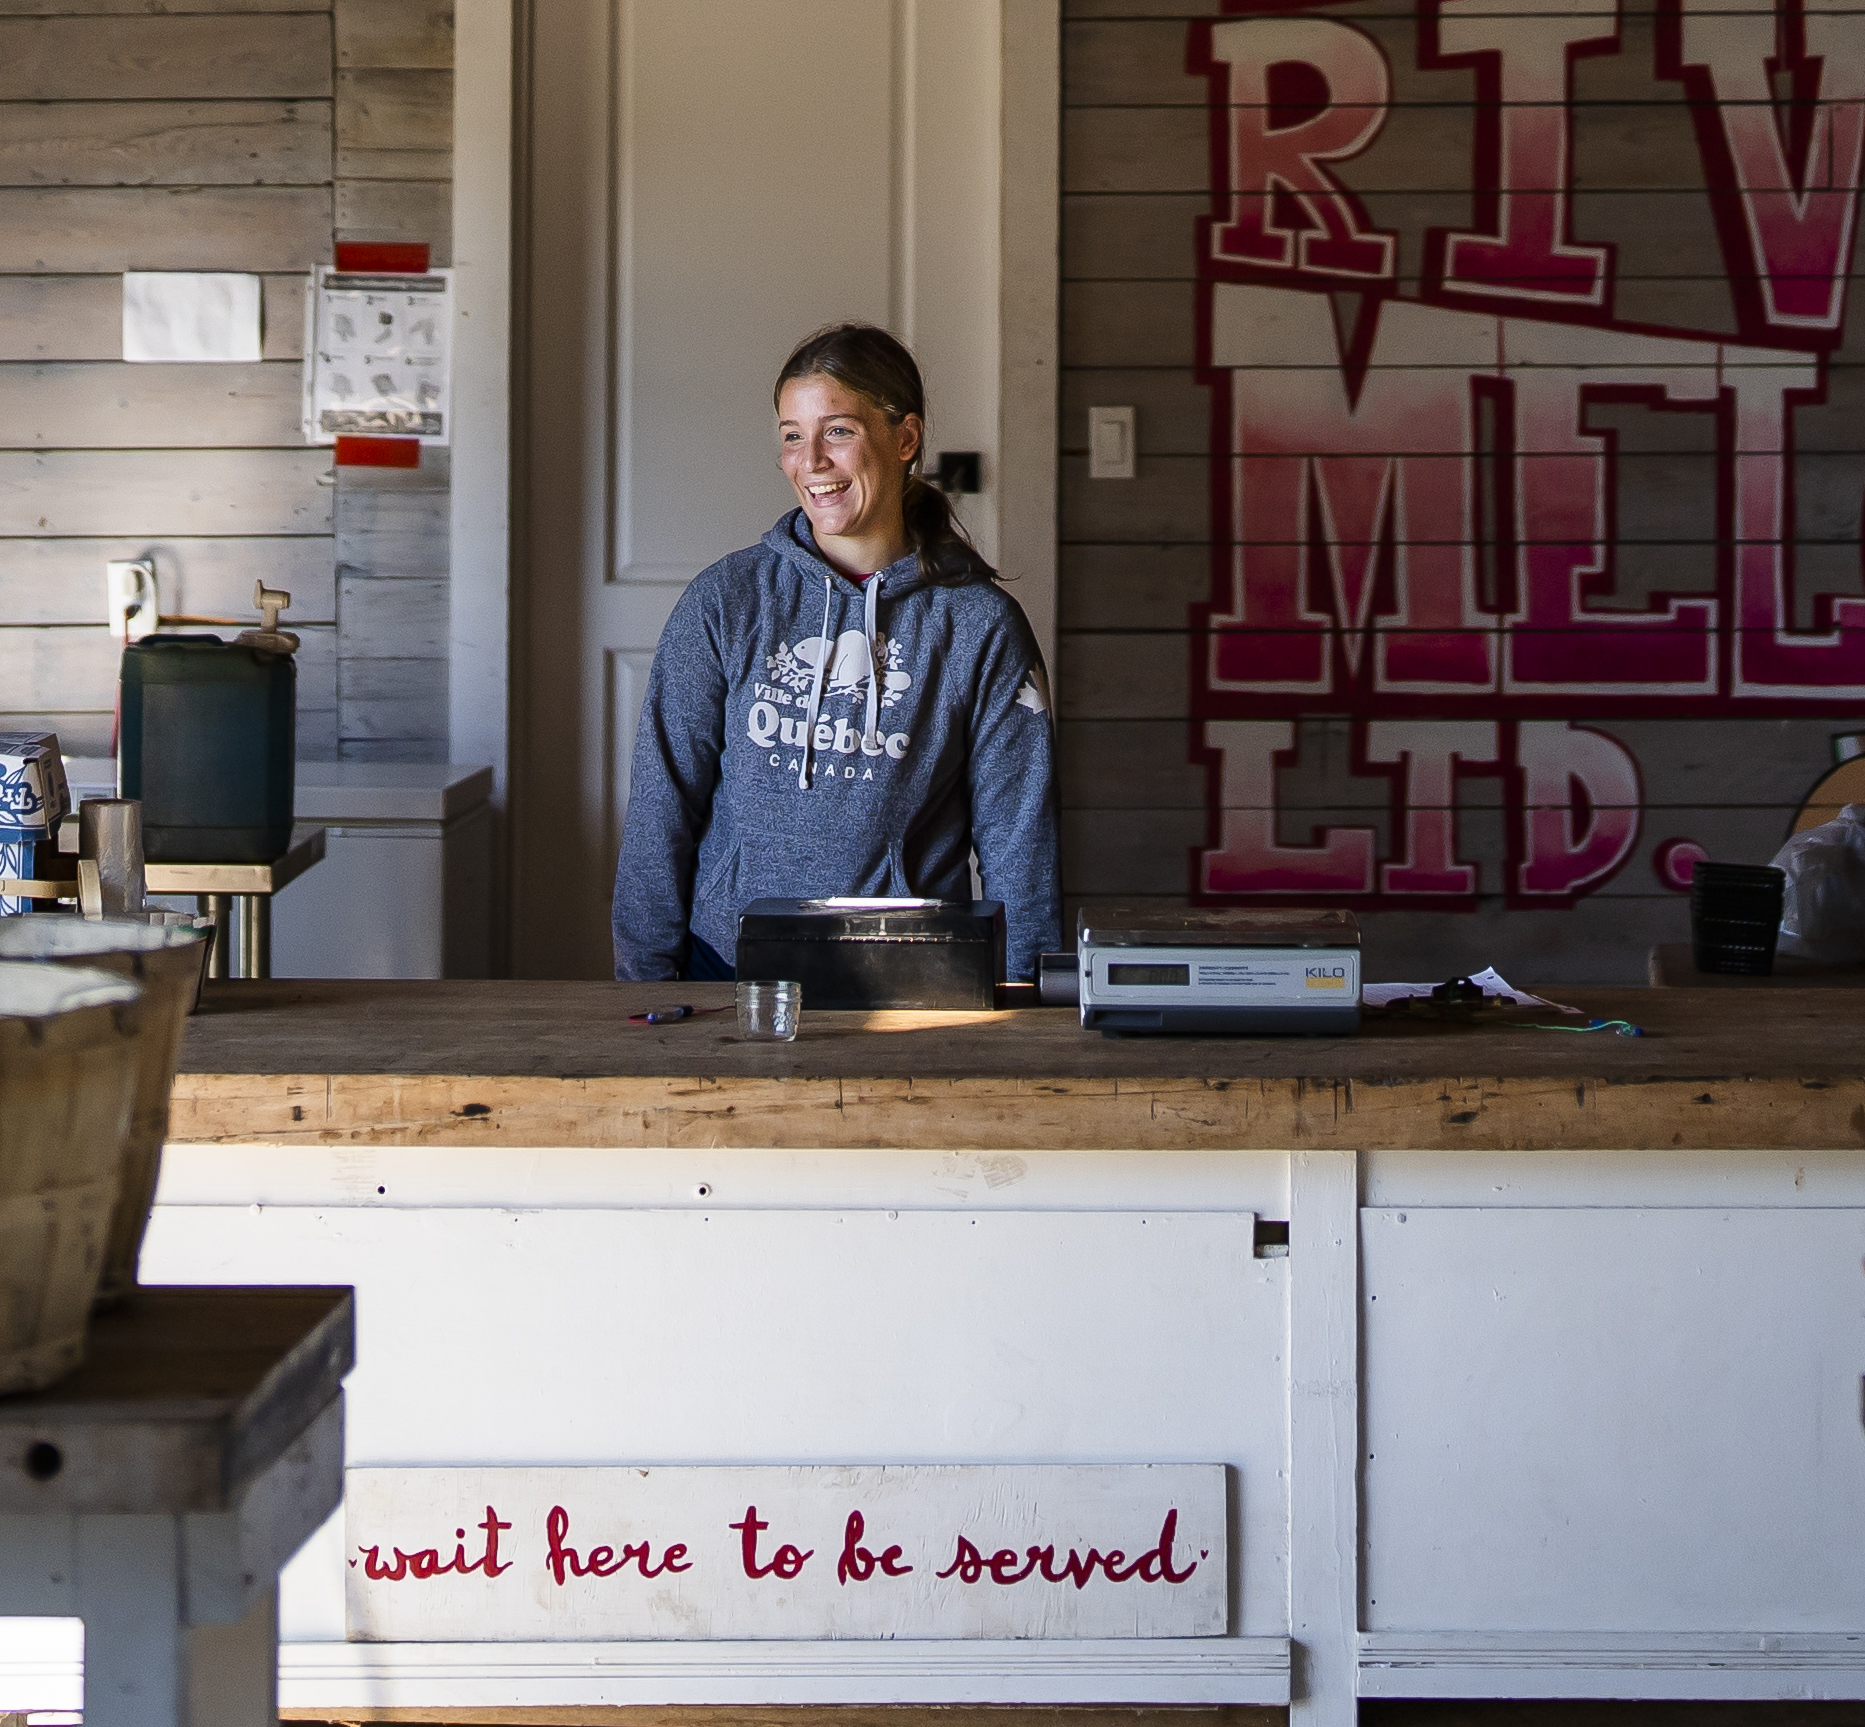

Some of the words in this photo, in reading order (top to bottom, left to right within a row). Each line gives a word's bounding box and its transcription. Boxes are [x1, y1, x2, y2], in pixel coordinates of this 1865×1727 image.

[754, 682, 792, 705] Ville
[796, 695, 810, 709] d
[747, 701, 911, 760] Québec
[1188, 717, 1708, 909] LTD.
[1305, 967, 1344, 978] KILO
[357, 1505, 513, 1581] wait
[545, 1504, 693, 1586] here
[729, 1505, 815, 1582] to
[837, 1509, 913, 1586] be
[935, 1508, 1199, 1590] served
